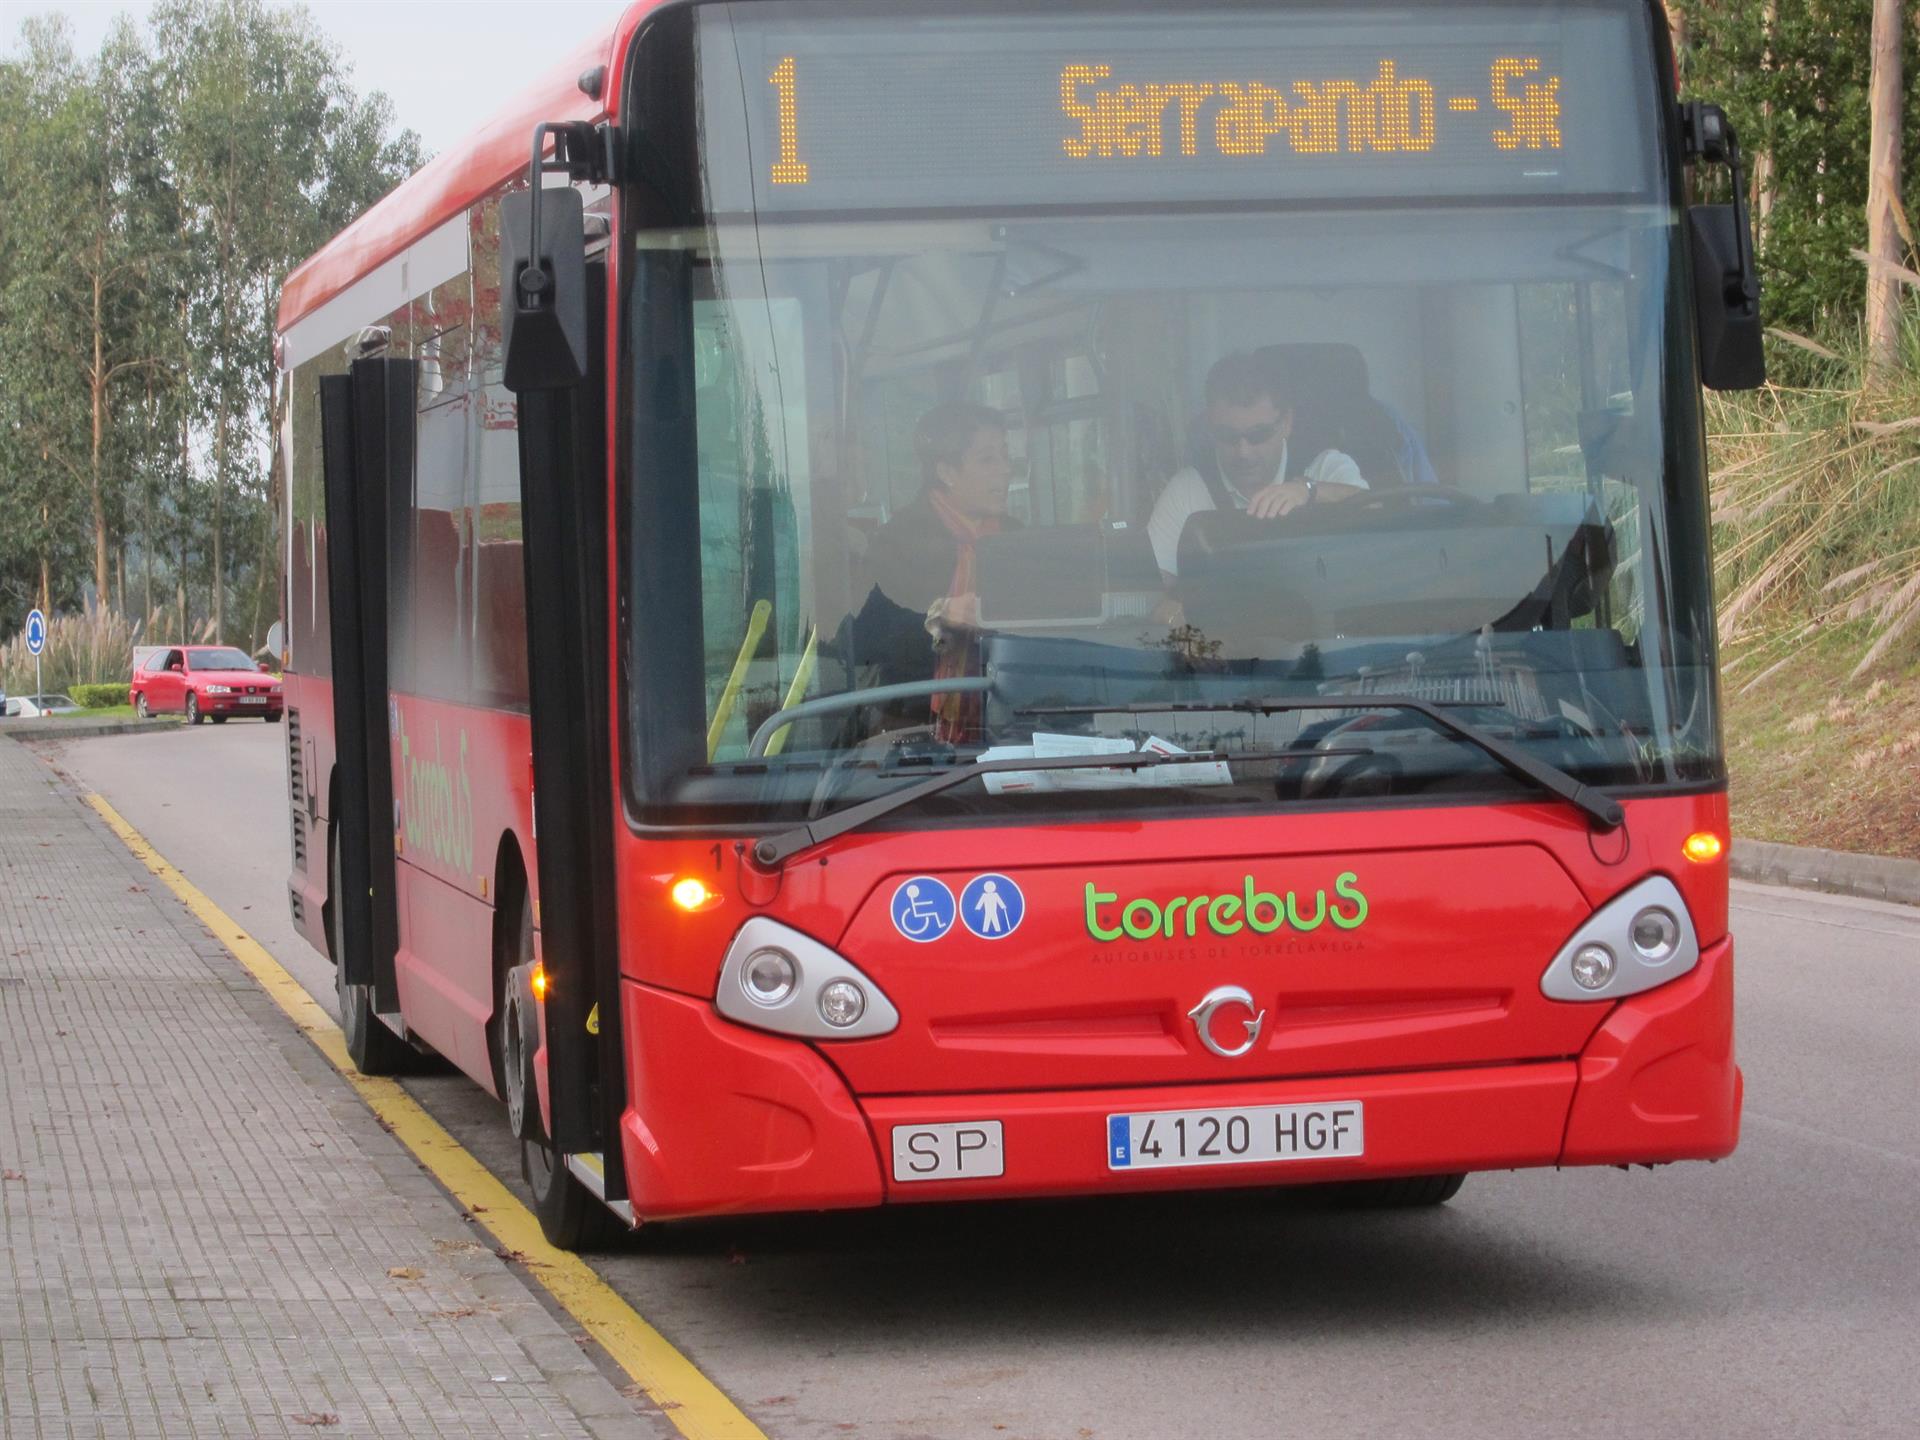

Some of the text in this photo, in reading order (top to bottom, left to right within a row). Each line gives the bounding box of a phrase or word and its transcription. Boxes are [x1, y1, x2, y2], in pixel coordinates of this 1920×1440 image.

[769, 57, 808, 184] 1
[709, 842, 723, 872] 1
[1091, 940, 1366, 964] AUTOBUSES DE TORRELAVEGA
[1139, 1109, 1356, 1159] 4120 HGF
[1116, 1146, 1126, 1159] E
